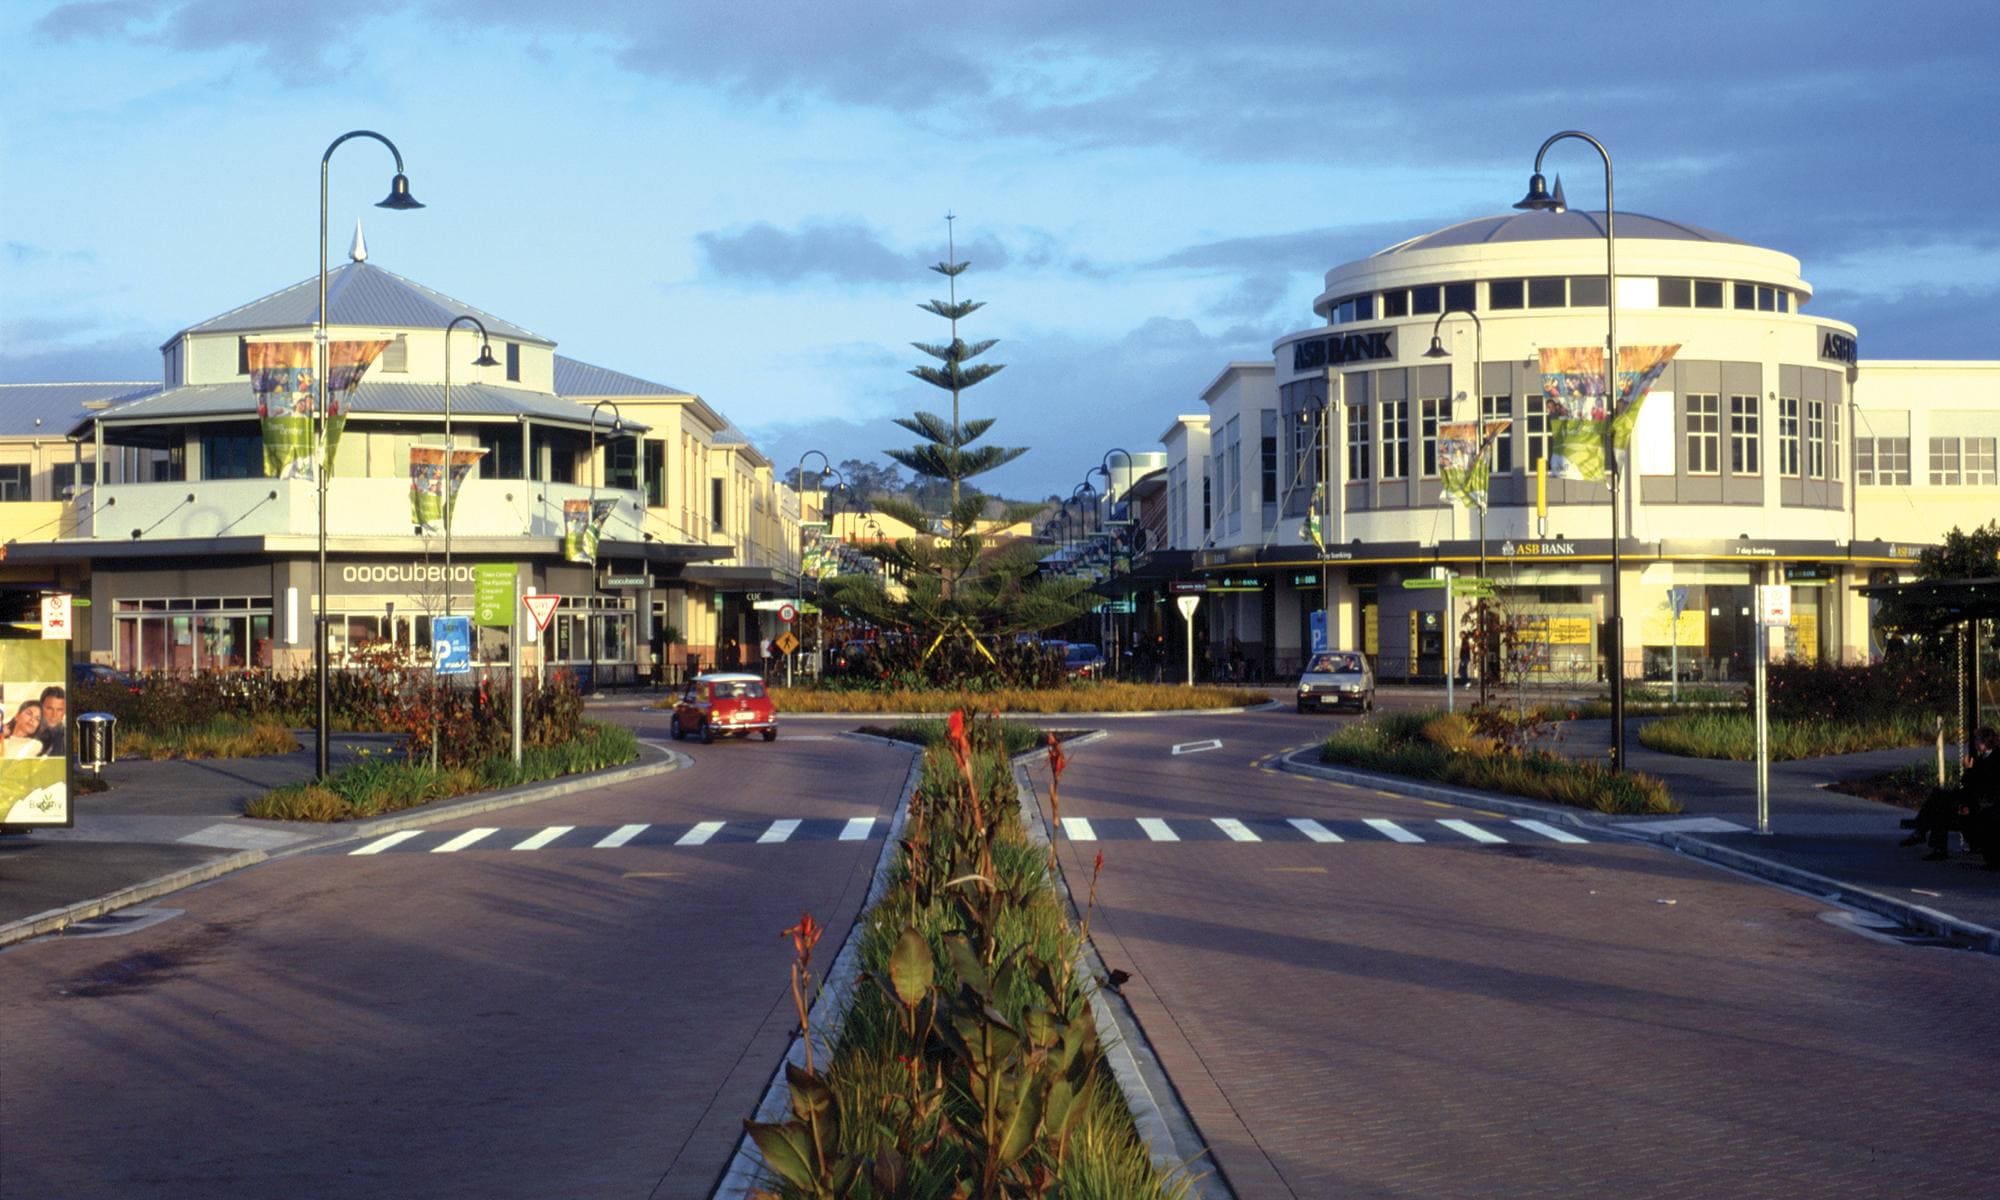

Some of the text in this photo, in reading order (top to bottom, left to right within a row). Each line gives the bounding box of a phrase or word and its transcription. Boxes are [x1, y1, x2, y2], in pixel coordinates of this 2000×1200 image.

[1294, 331, 1393, 370] ASB BANK
[1517, 543, 1575, 555] ASB BANK
[1741, 547, 1752, 556] day
[1753, 547, 1776, 556] banking
[1331, 552, 1352, 560] banking
[435, 640, 452, 670] P
